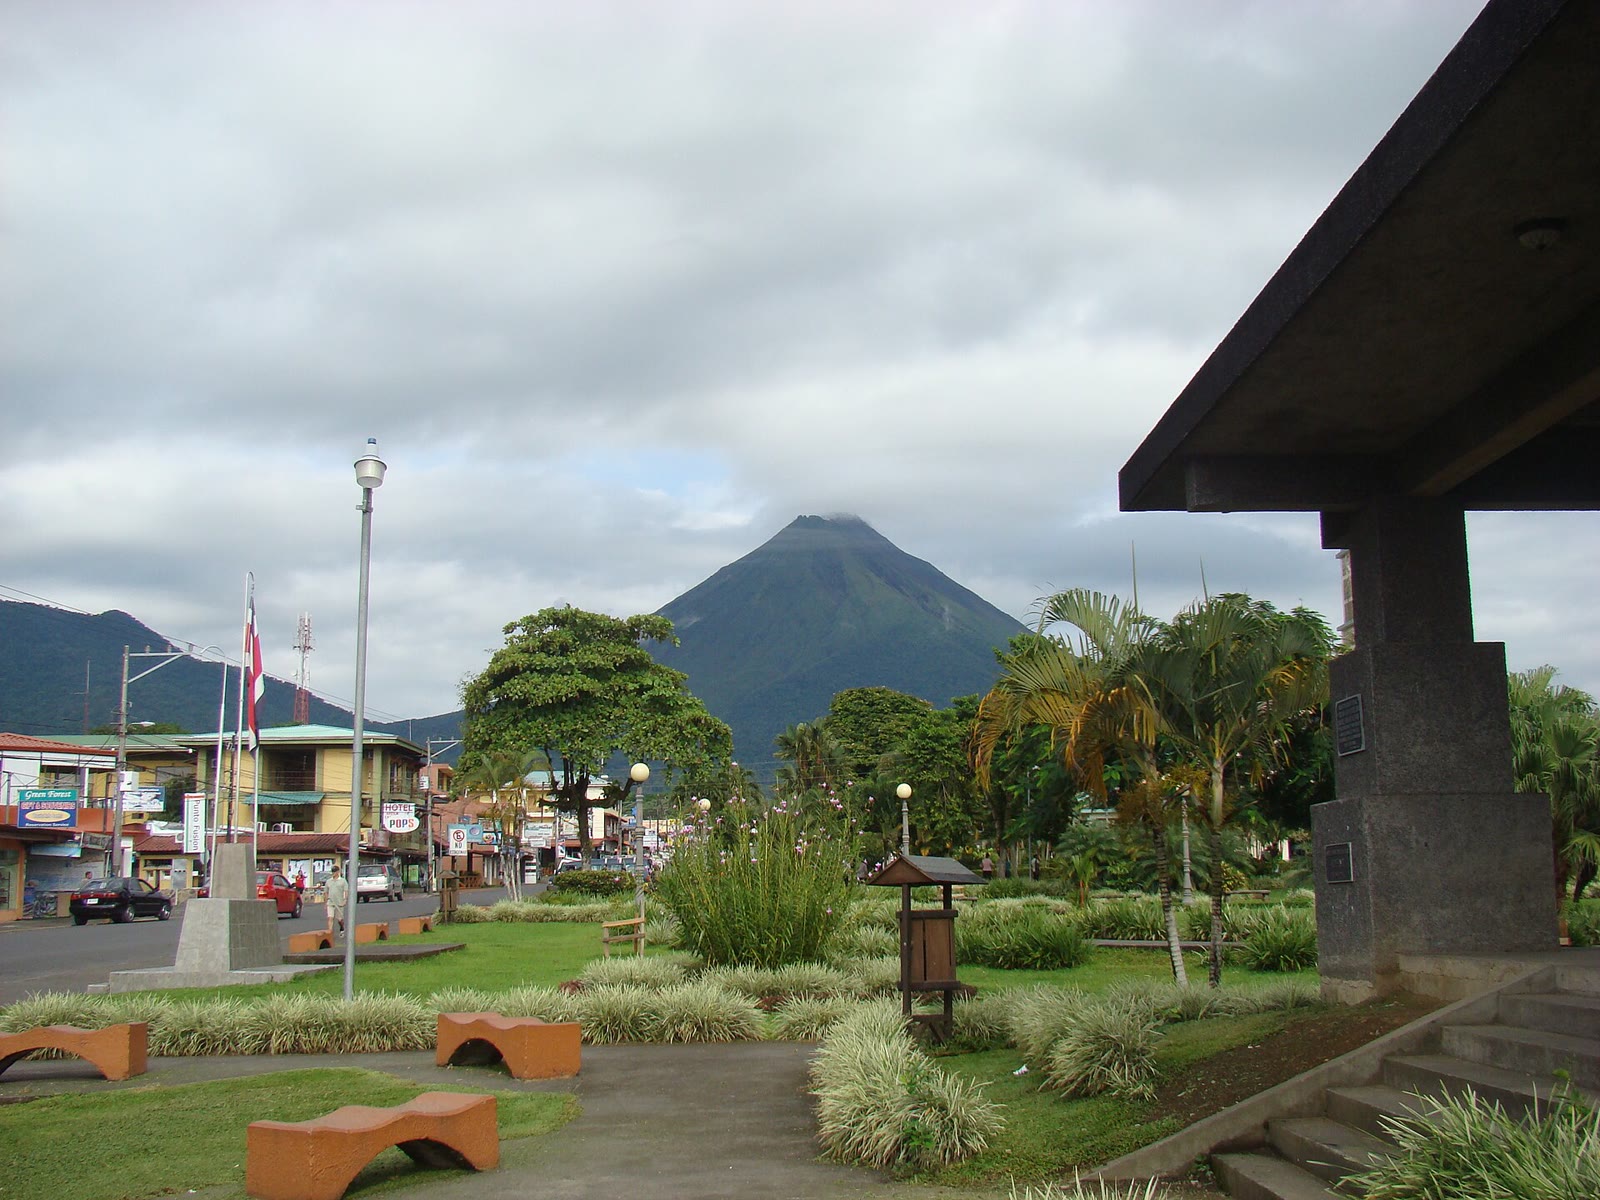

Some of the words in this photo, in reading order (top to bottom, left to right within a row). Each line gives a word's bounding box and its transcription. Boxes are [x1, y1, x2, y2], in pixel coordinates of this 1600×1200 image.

[25, 790, 46, 800] Green
[47, 790, 72, 798] Forest
[390, 819, 414, 828] POPS
